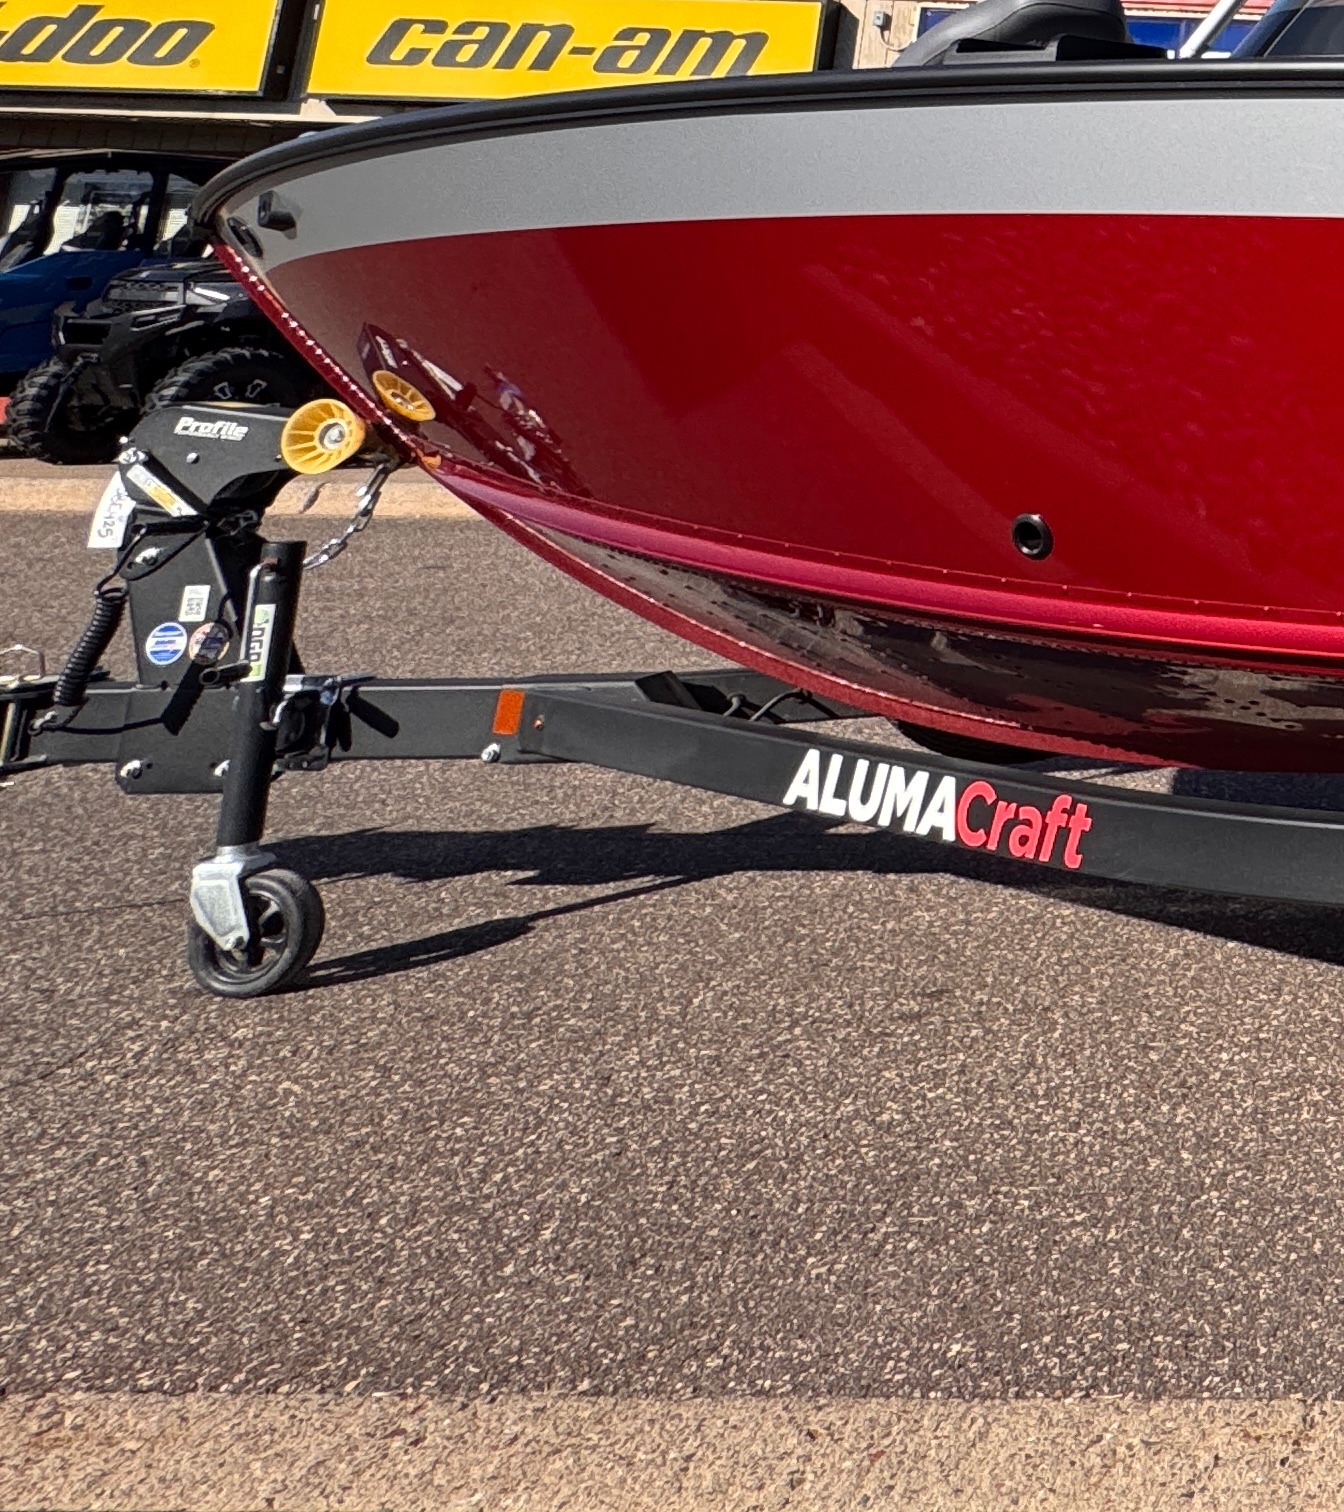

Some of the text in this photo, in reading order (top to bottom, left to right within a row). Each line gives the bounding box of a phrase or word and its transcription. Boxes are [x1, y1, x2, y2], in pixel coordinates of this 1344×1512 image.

[0, 1, 215, 66] doo
[365, 17, 770, 78] can-am
[173, 416, 250, 437] Profile
[782, 749, 1093, 870] ALUMACraft
